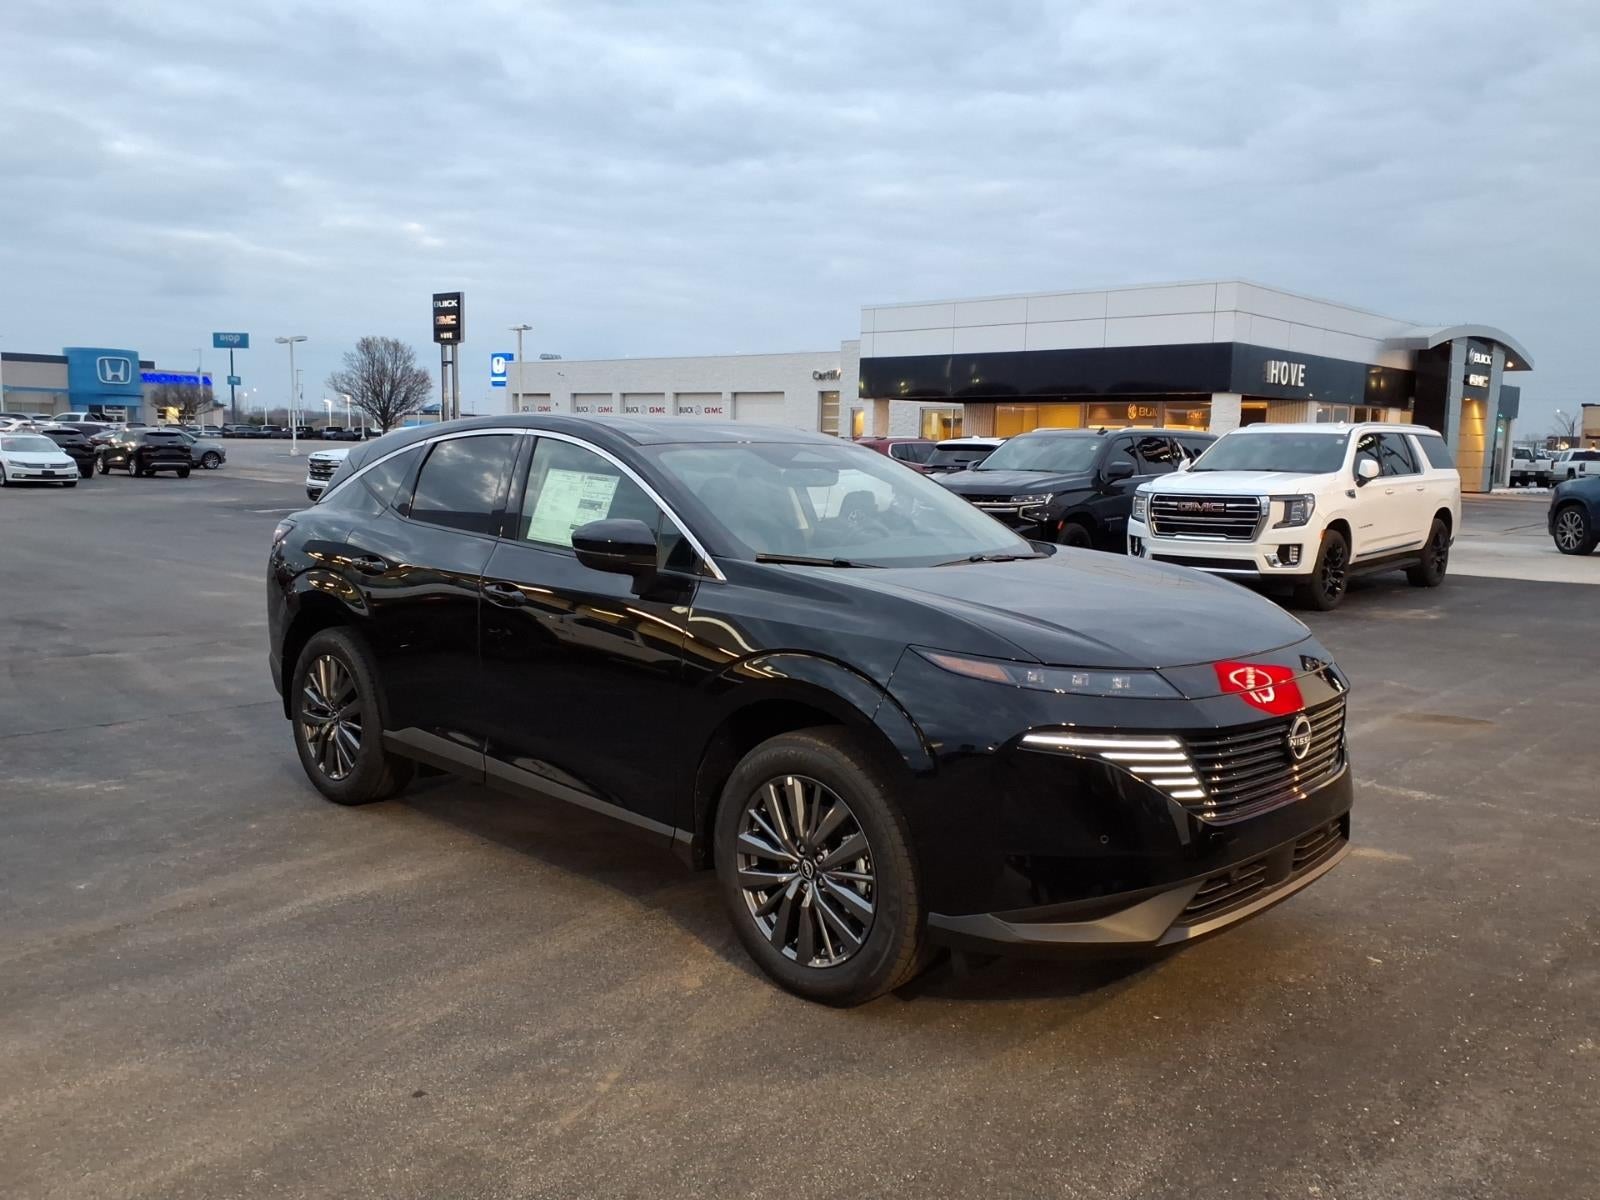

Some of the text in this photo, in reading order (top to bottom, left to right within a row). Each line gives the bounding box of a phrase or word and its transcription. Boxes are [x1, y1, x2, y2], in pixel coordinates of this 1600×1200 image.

[435, 315, 456, 324] GMC
[1269, 360, 1306, 387] HOVE
[597, 406, 614, 414] GMC
[648, 406, 666, 414] GMC
[704, 406, 724, 415] GMC
[1178, 501, 1225, 513] GMC
